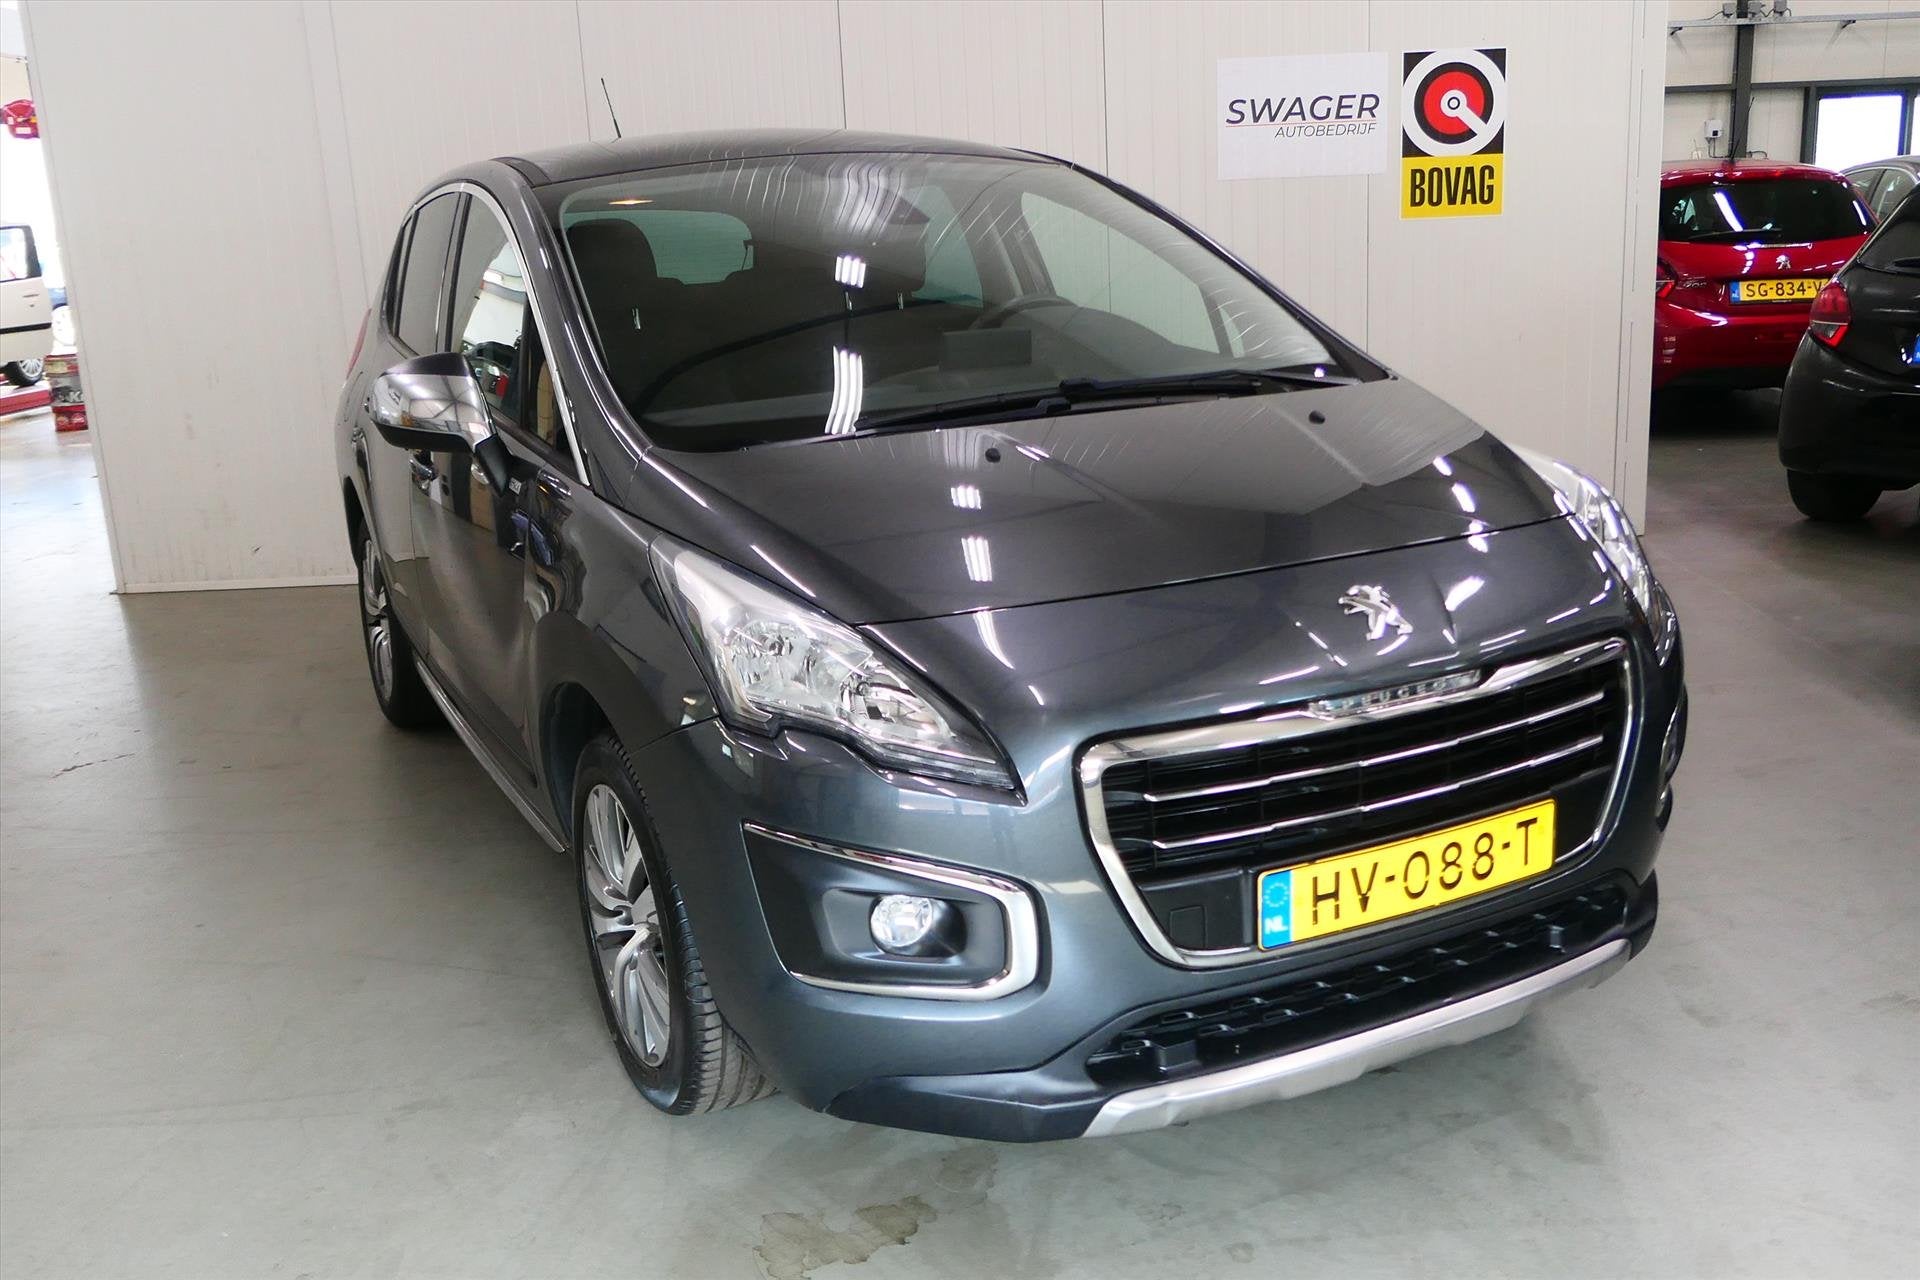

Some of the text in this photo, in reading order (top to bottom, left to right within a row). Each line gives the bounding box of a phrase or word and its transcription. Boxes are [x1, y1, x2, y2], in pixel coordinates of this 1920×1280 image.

[1225, 93, 1380, 124] SWAGER
[1275, 122, 1377, 138] AUTOBEDRIJF
[1409, 164, 1495, 207] BOVAG
[1343, 673, 1468, 711] PEUGEO
[1312, 816, 1538, 925] HV-088-T
[1264, 915, 1288, 935] NL
